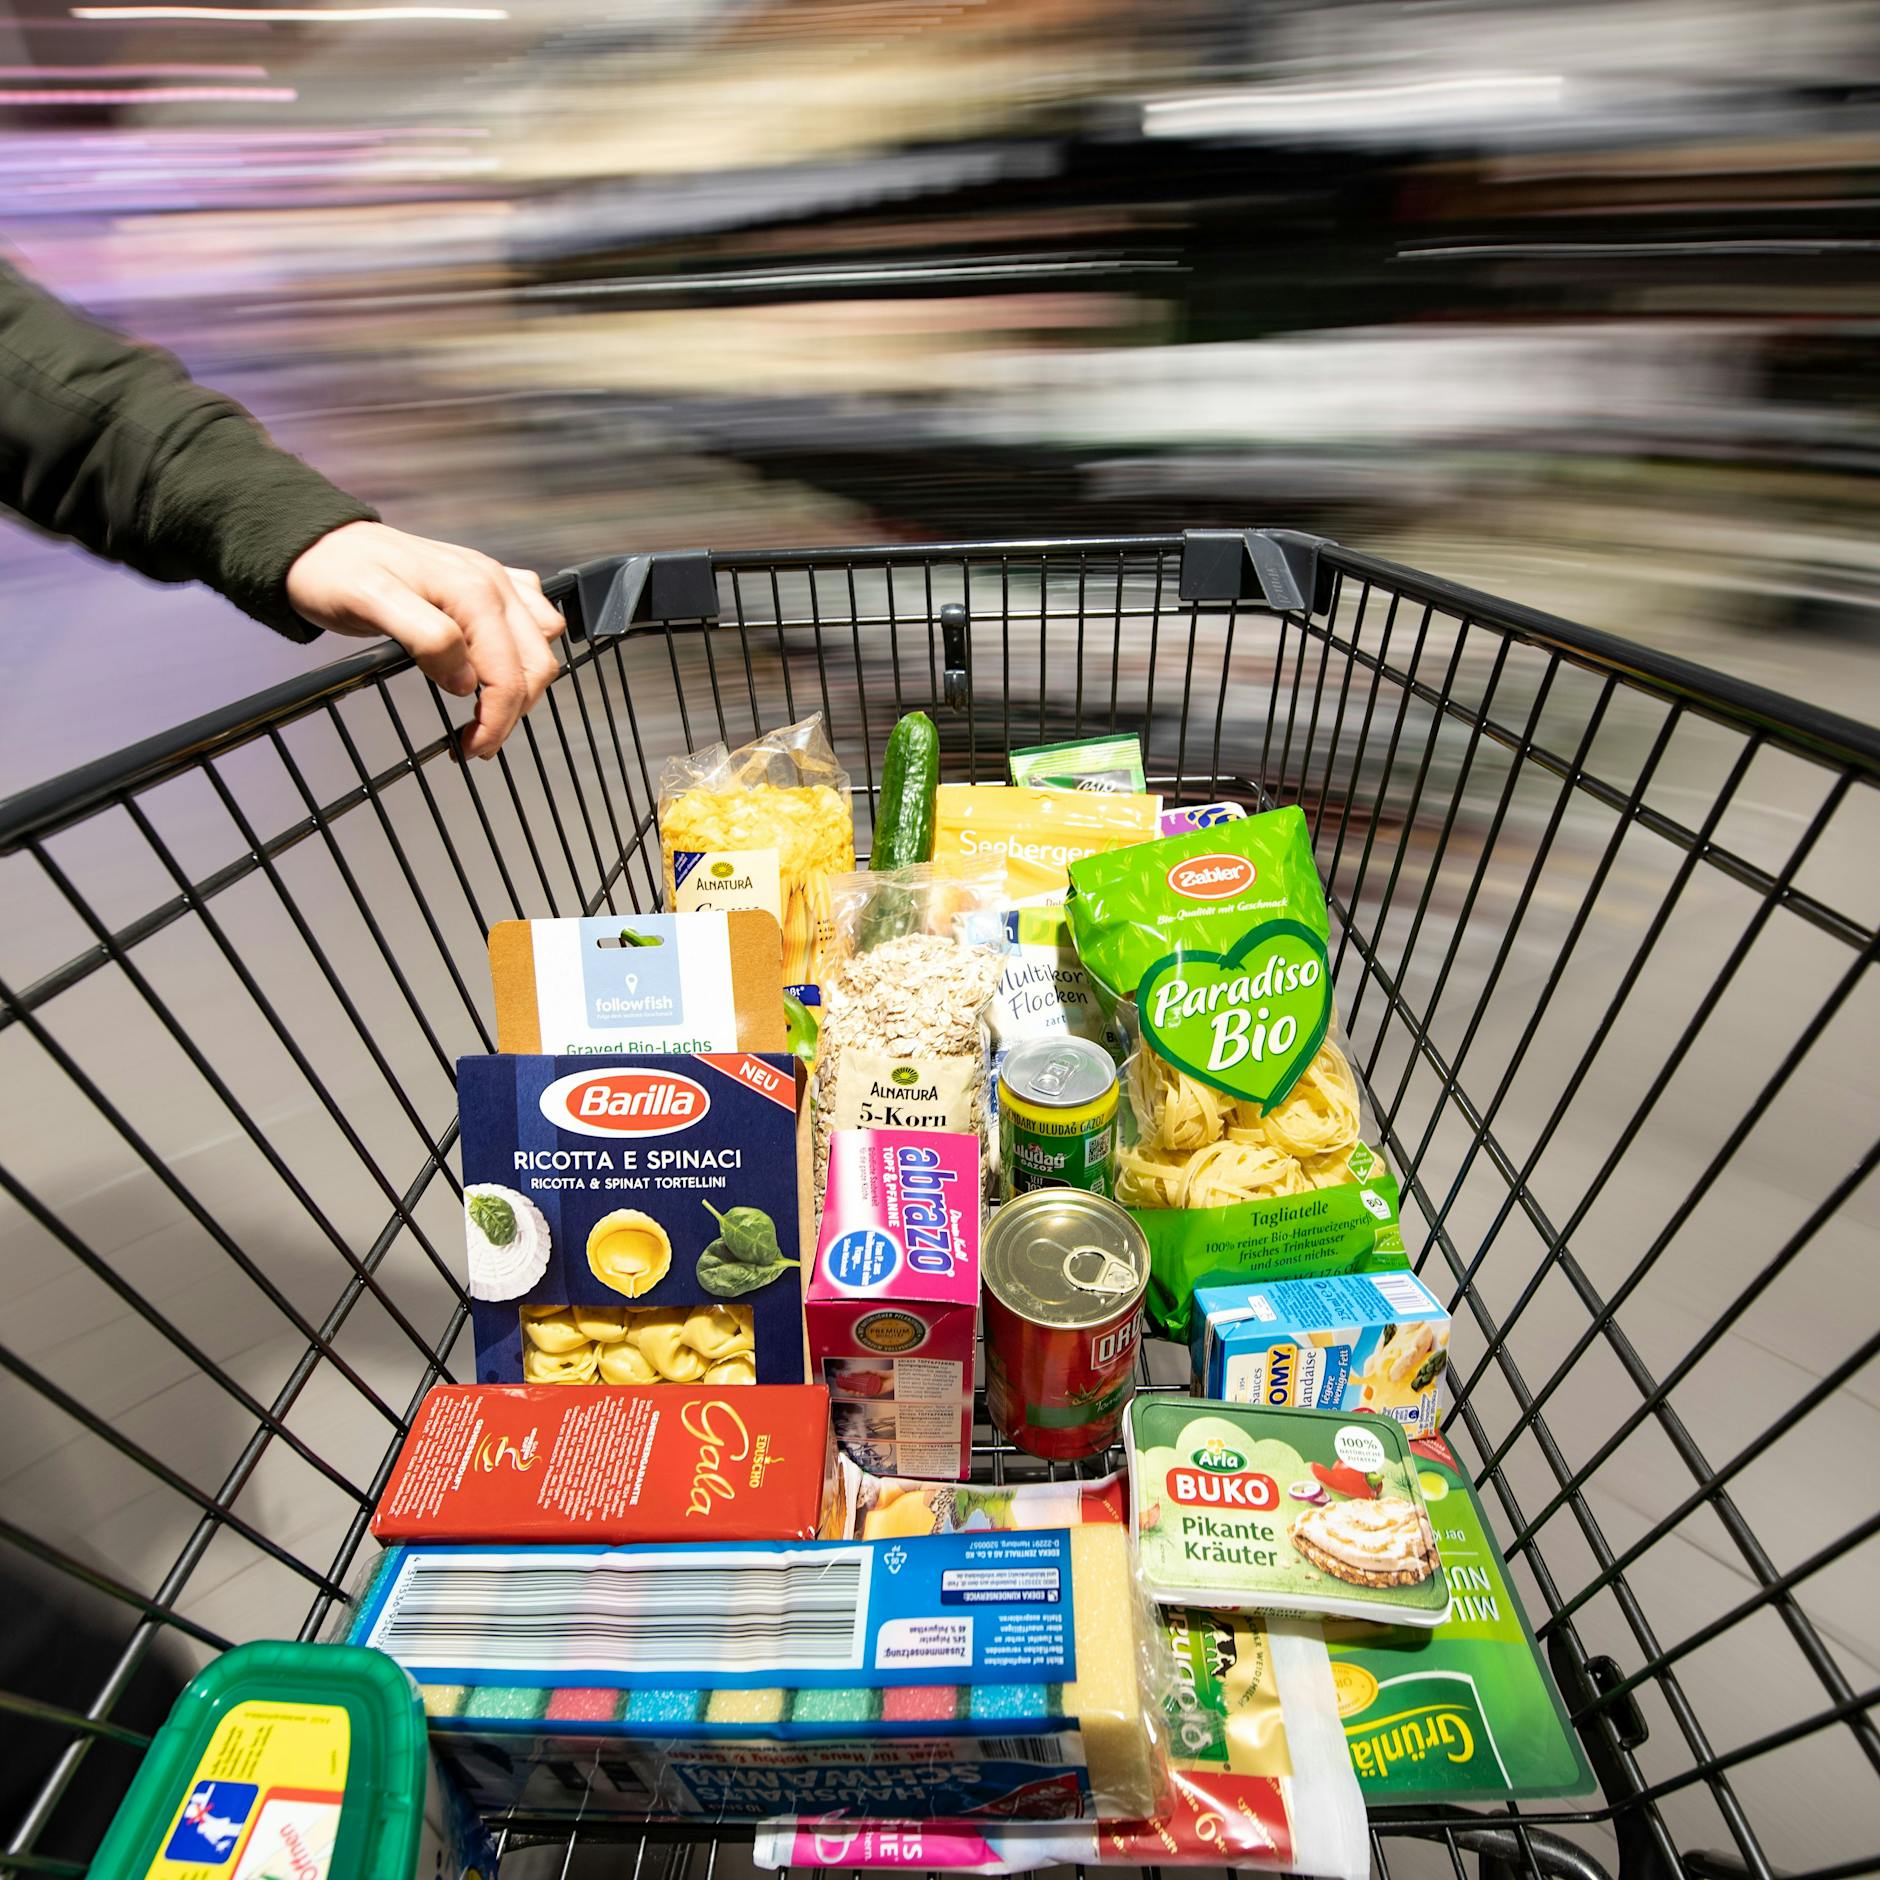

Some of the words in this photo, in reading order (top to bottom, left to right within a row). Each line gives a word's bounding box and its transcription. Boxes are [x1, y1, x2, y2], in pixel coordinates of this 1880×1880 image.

[959, 830, 1096, 863] Seeberger
[697, 876, 753, 890] ALNATURA
[1179, 865, 1243, 887] Zabler
[1157, 906, 1216, 925] Bio-Qualität
[1218, 904, 1235, 916] mit
[1237, 897, 1289, 912] Geschmack
[997, 963, 1087, 996] Multikor
[1008, 986, 1088, 1020] Flocken
[1154, 955, 1320, 1028] Paradiso
[595, 995, 673, 1012] followfish
[1045, 1013, 1066, 1027] zart
[629, 1038, 713, 1054] Bio-Lachs
[1207, 1007, 1297, 1072] Bio
[739, 1061, 779, 1092] NEU
[579, 1084, 695, 1116] Barilla
[870, 1081, 939, 1101] ALNATURA
[859, 1102, 947, 1128] 5-Korn
[1039, 1121, 1077, 1136] ULUDAĞ
[1080, 1113, 1105, 1133] GAZOZ
[514, 1151, 614, 1170] RICOTTA
[624, 1151, 638, 1169] E
[647, 1149, 741, 1169] SPINACI
[1013, 1143, 1066, 1169] uludağ
[1021, 1158, 1054, 1173] GAZOZ
[531, 1177, 585, 1190] RICOTTA
[590, 1177, 600, 1190] &
[604, 1177, 650, 1190] SPINAT
[656, 1176, 726, 1189] TORTELLINI
[870, 1176, 880, 1207] Sauberkeit
[897, 1147, 957, 1275] abrazo
[1251, 1200, 1329, 1228] Tagliatelle
[1206, 1242, 1235, 1253] 100%
[1237, 1235, 1269, 1249] reiner
[1271, 1213, 1373, 1242] Bio-Hartweizengrieß
[1239, 1249, 1280, 1264] frisches
[1284, 1234, 1345, 1251] Trinkwasser
[1250, 1259, 1271, 1271] und
[1274, 1254, 1301, 1266] sonst
[1305, 1248, 1338, 1261] nichts.
[1339, 1346, 1349, 1367] Fett
[1252, 1367, 1262, 1404] Sauces
[1269, 1350, 1291, 1405] OMY
[1298, 1351, 1317, 1408] landaise
[1332, 1368, 1348, 1404] weniger
[1321, 1375, 1335, 1405] légère
[452, 1419, 484, 1491] GENIESSERDUFT
[1340, 1437, 1378, 1451] 100%
[1340, 1448, 1382, 1457] NATÜRLICHE
[629, 1411, 660, 1506] GENIESSERGARANTIE
[681, 1400, 751, 1518] Gala
[748, 1434, 768, 1489] EDUSCHO
[1199, 1450, 1238, 1469] Arla
[1347, 1455, 1377, 1464] ZUTATEN
[1176, 1474, 1269, 1506] BUKO
[1182, 1516, 1275, 1542] Pikante
[1446, 1530, 1466, 1542] Der
[993, 1550, 1003, 1558] AG
[1004, 1549, 1037, 1558] ZENTRALE
[1032, 1539, 1059, 1547] D-22291
[1038, 1548, 1060, 1557] EDEKA
[1185, 1541, 1277, 1567] Kräuter
[965, 1551, 975, 1559] KG
[1444, 1566, 1491, 1591] NU
[963, 1591, 1021, 1602] KUNDENSERVICE:
[1021, 1590, 1045, 1601] EDEKA
[1256, 1606, 1306, 1616] Pikante
[1446, 1596, 1500, 1623] MIL
[909, 1624, 948, 1634] Polyurethan
[919, 1634, 951, 1644] Polyester
[883, 1647, 966, 1659] Zusammensetzung:
[1238, 1651, 1263, 1708] WEIDEMILCH
[812, 1750, 866, 1762] Haus,
[872, 1749, 899, 1760] für
[907, 1749, 956, 1760] Ideal
[1352, 1712, 1475, 1778] Grünlä
[750, 1751, 806, 1764] Hobby
[681, 1763, 982, 1787] SCHWAMM
[694, 1785, 926, 1802] HAUSHALTS
[1195, 1811, 1225, 1842] 6
